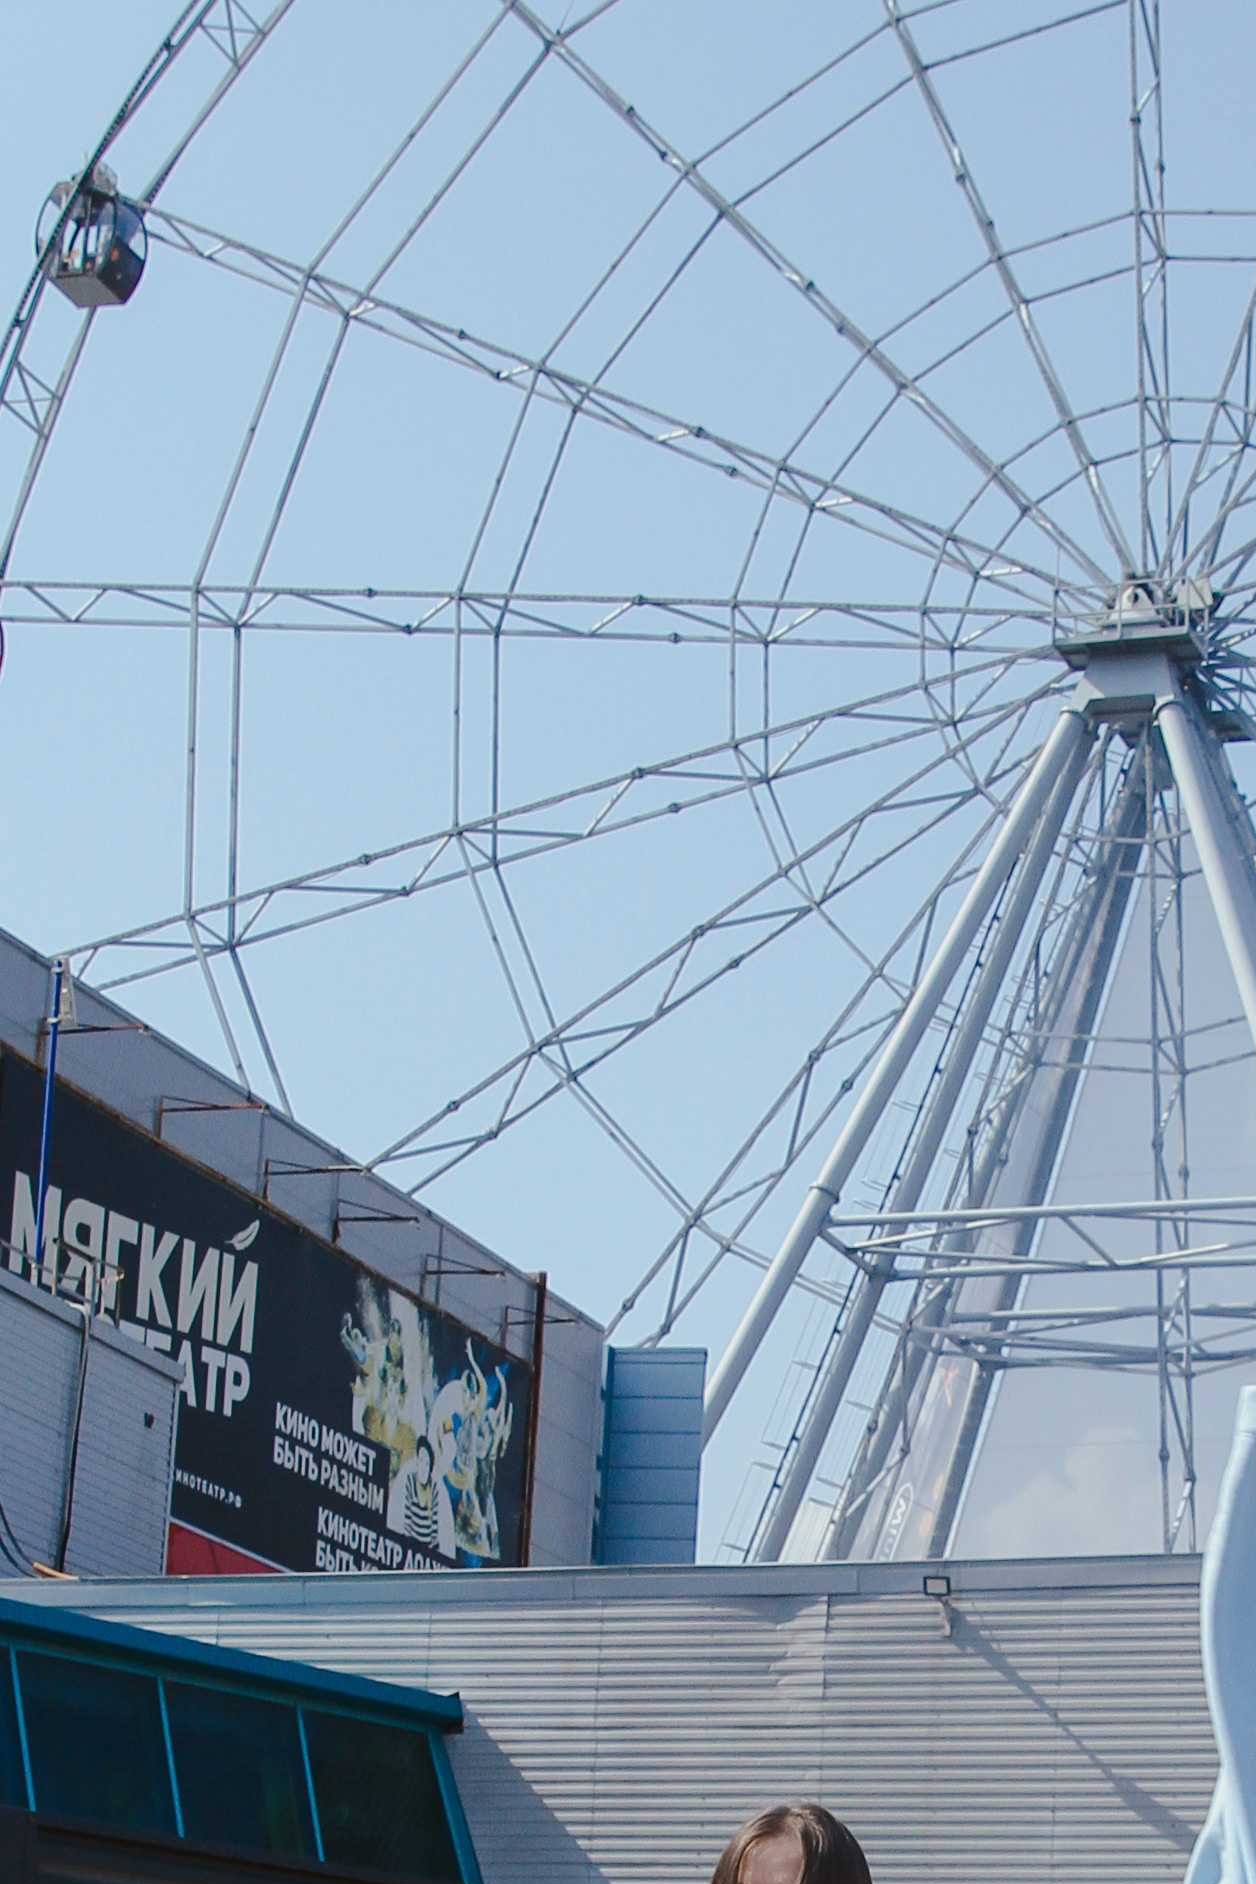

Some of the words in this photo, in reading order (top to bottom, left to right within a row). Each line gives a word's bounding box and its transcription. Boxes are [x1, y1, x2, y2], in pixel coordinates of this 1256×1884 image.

[8, 1169, 260, 1355] МЯГКИЙ
[273, 1435, 319, 1482] БЫТЬ
[320, 1458, 385, 1515] РАЗНЫМ
[275, 1401, 320, 1448] КИНО
[320, 1424, 377, 1477] МОЖЕТ
[317, 1506, 403, 1569] КИНОТЕАТР
